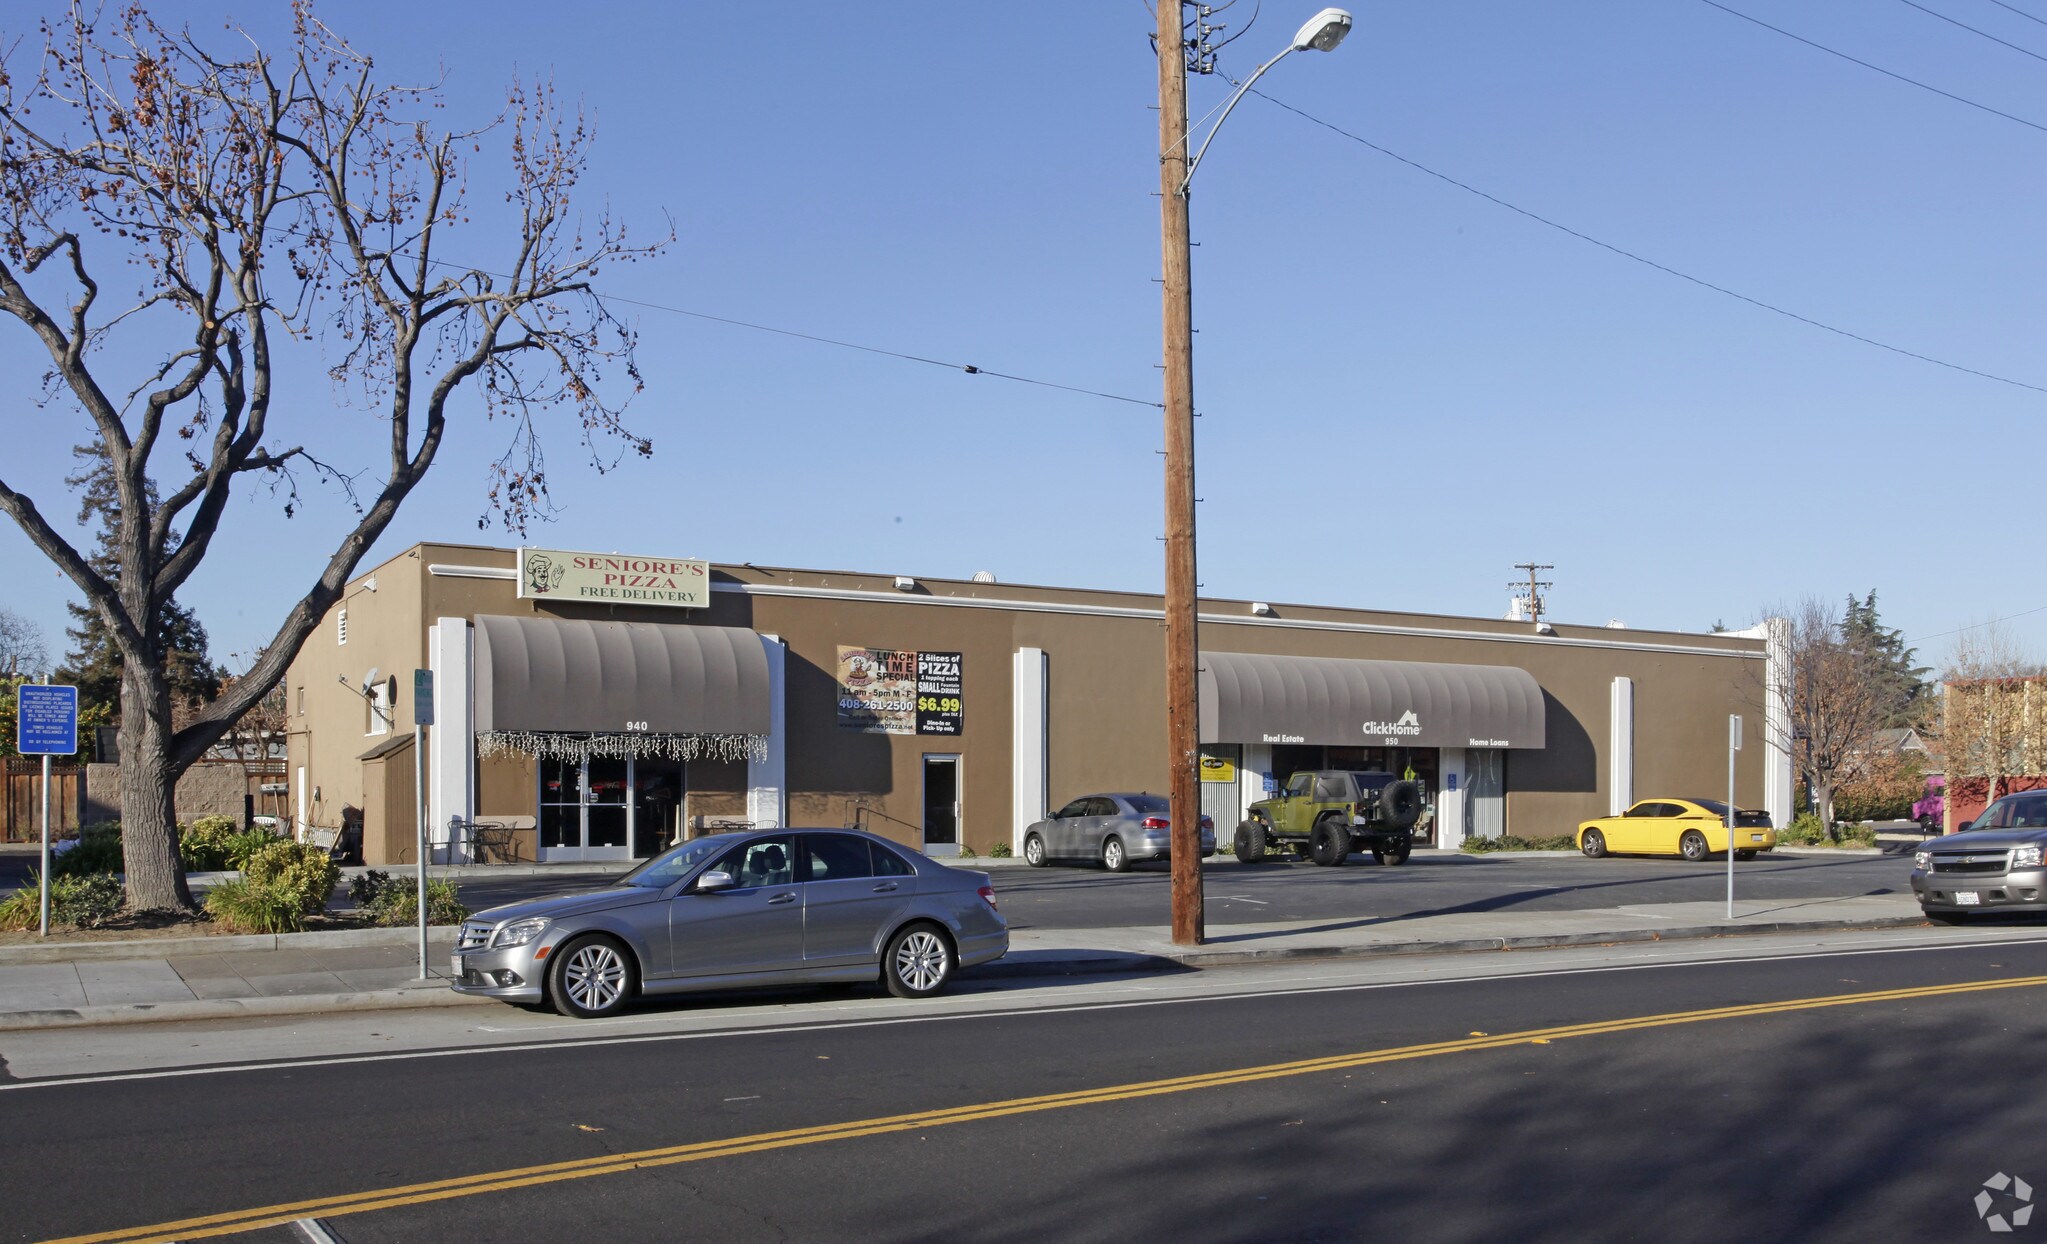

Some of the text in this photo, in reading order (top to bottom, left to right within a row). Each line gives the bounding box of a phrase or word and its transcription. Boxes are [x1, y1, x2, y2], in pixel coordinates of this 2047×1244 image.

[573, 556, 704, 577] SENIORE'S
[604, 573, 677, 589] PIZZA
[580, 586, 697, 602] FREE DELIVERY
[876, 651, 914, 662] LUNCH
[925, 654, 950, 662] Slices
[876, 661, 913, 672] TIME
[918, 662, 960, 676] PIZZA
[876, 672, 915, 682] SPECIAL
[918, 681, 941, 693] SMALL
[873, 689, 891, 698] 5pm
[839, 698, 914, 712] 408-261-2500
[918, 696, 960, 712] $6.99
[626, 721, 648, 731] 940
[1362, 721, 1420, 736] ClickHome
[1263, 733, 1305, 743] Real Estate
[1384, 737, 1399, 745] 950
[1469, 738, 1509, 747] Home Loans
